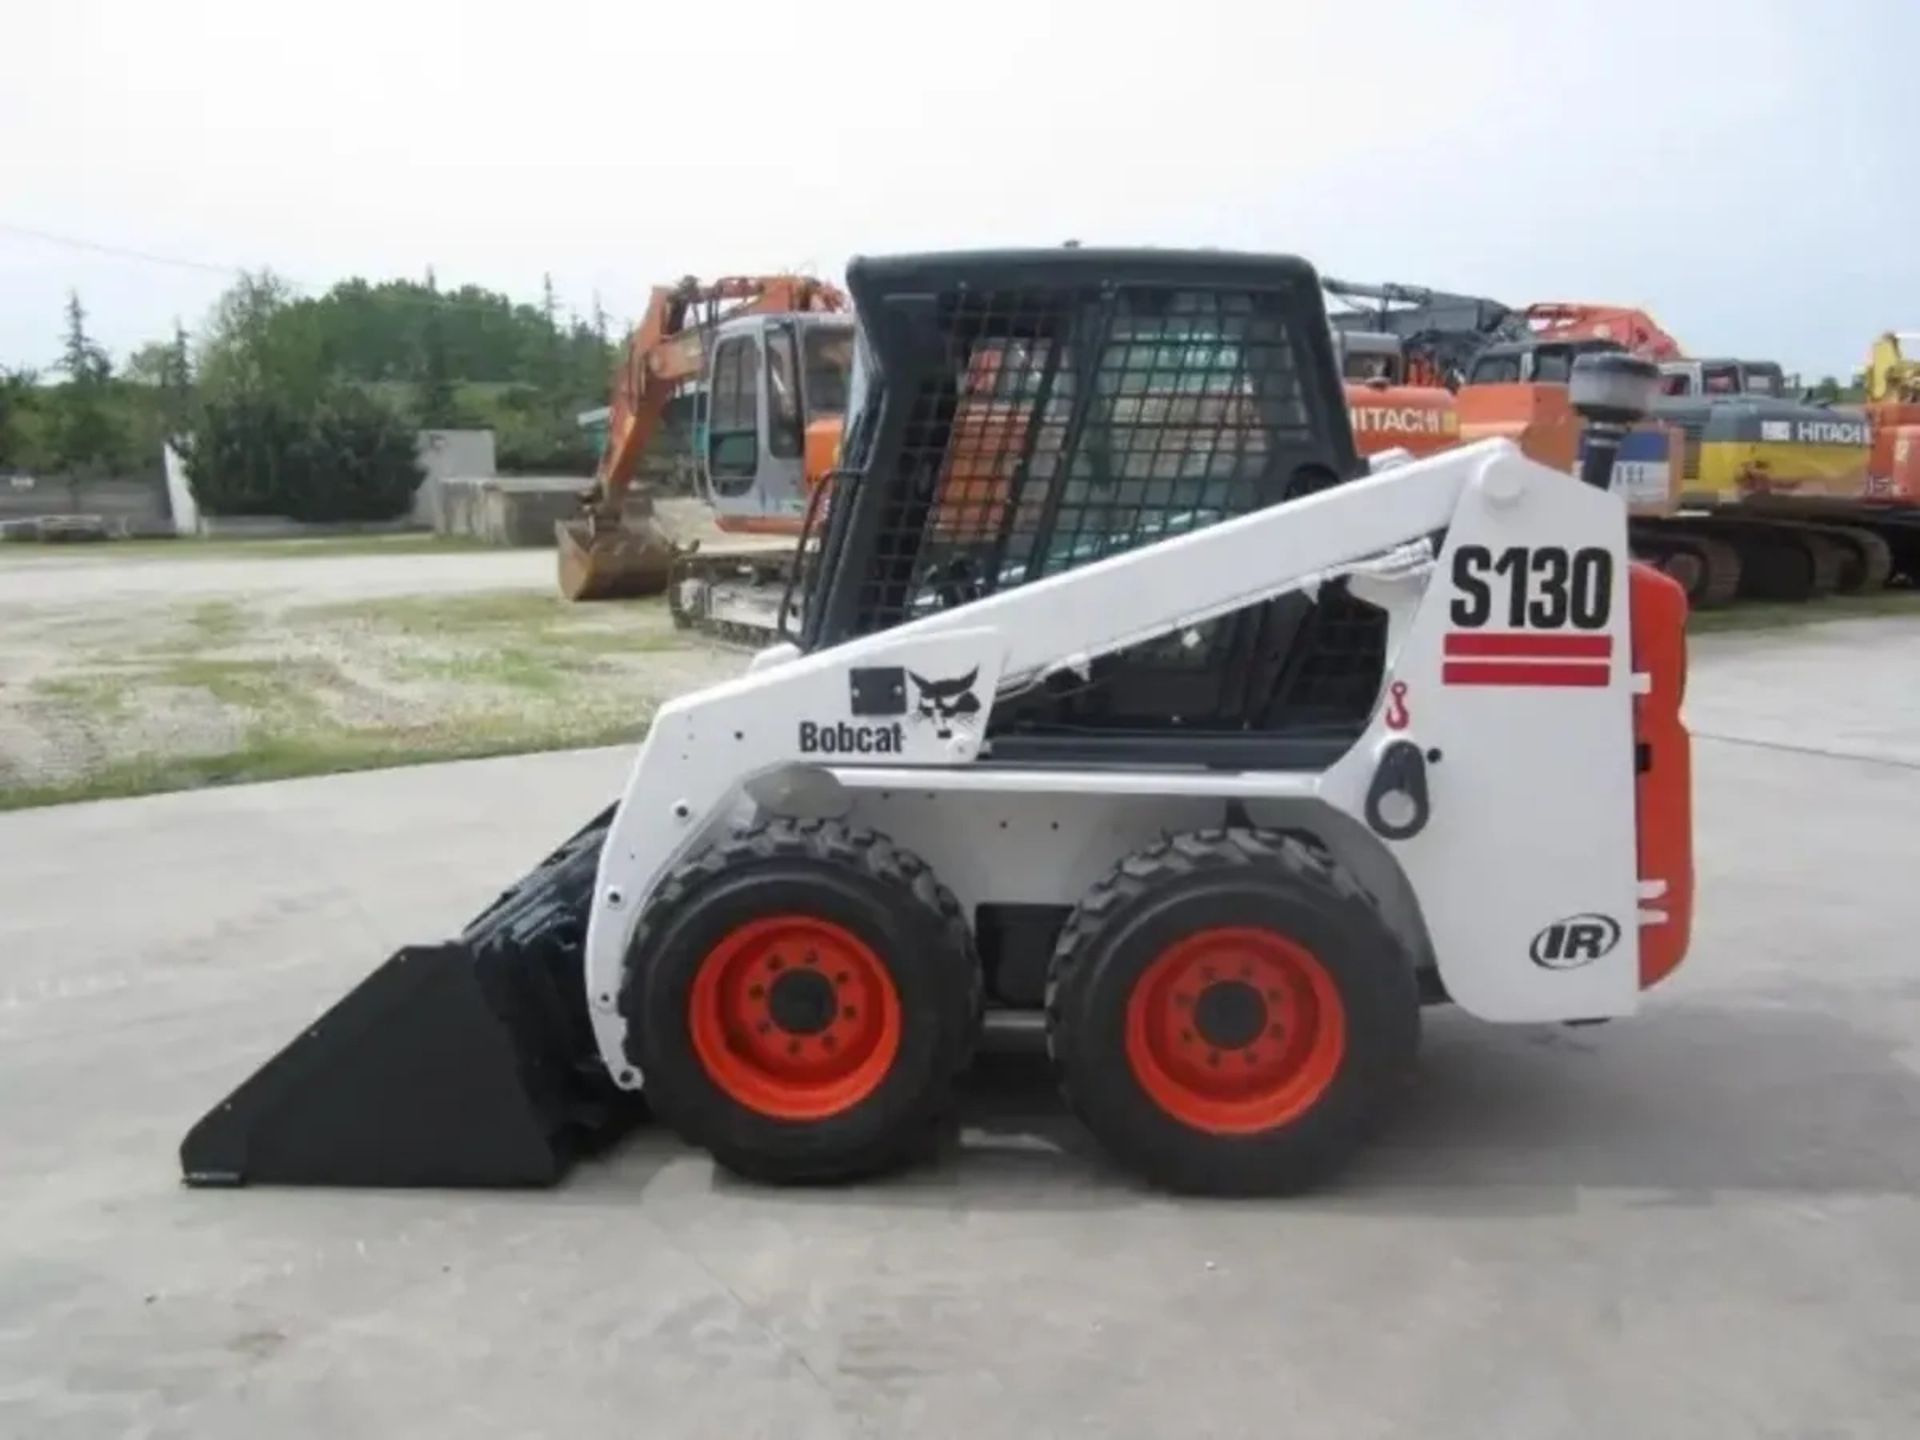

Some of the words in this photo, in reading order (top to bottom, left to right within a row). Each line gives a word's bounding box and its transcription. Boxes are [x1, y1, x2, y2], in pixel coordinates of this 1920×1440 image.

[1450, 545, 1613, 629] S130
[800, 721, 906, 753] Bobcat
[1543, 924, 1604, 959] IR
